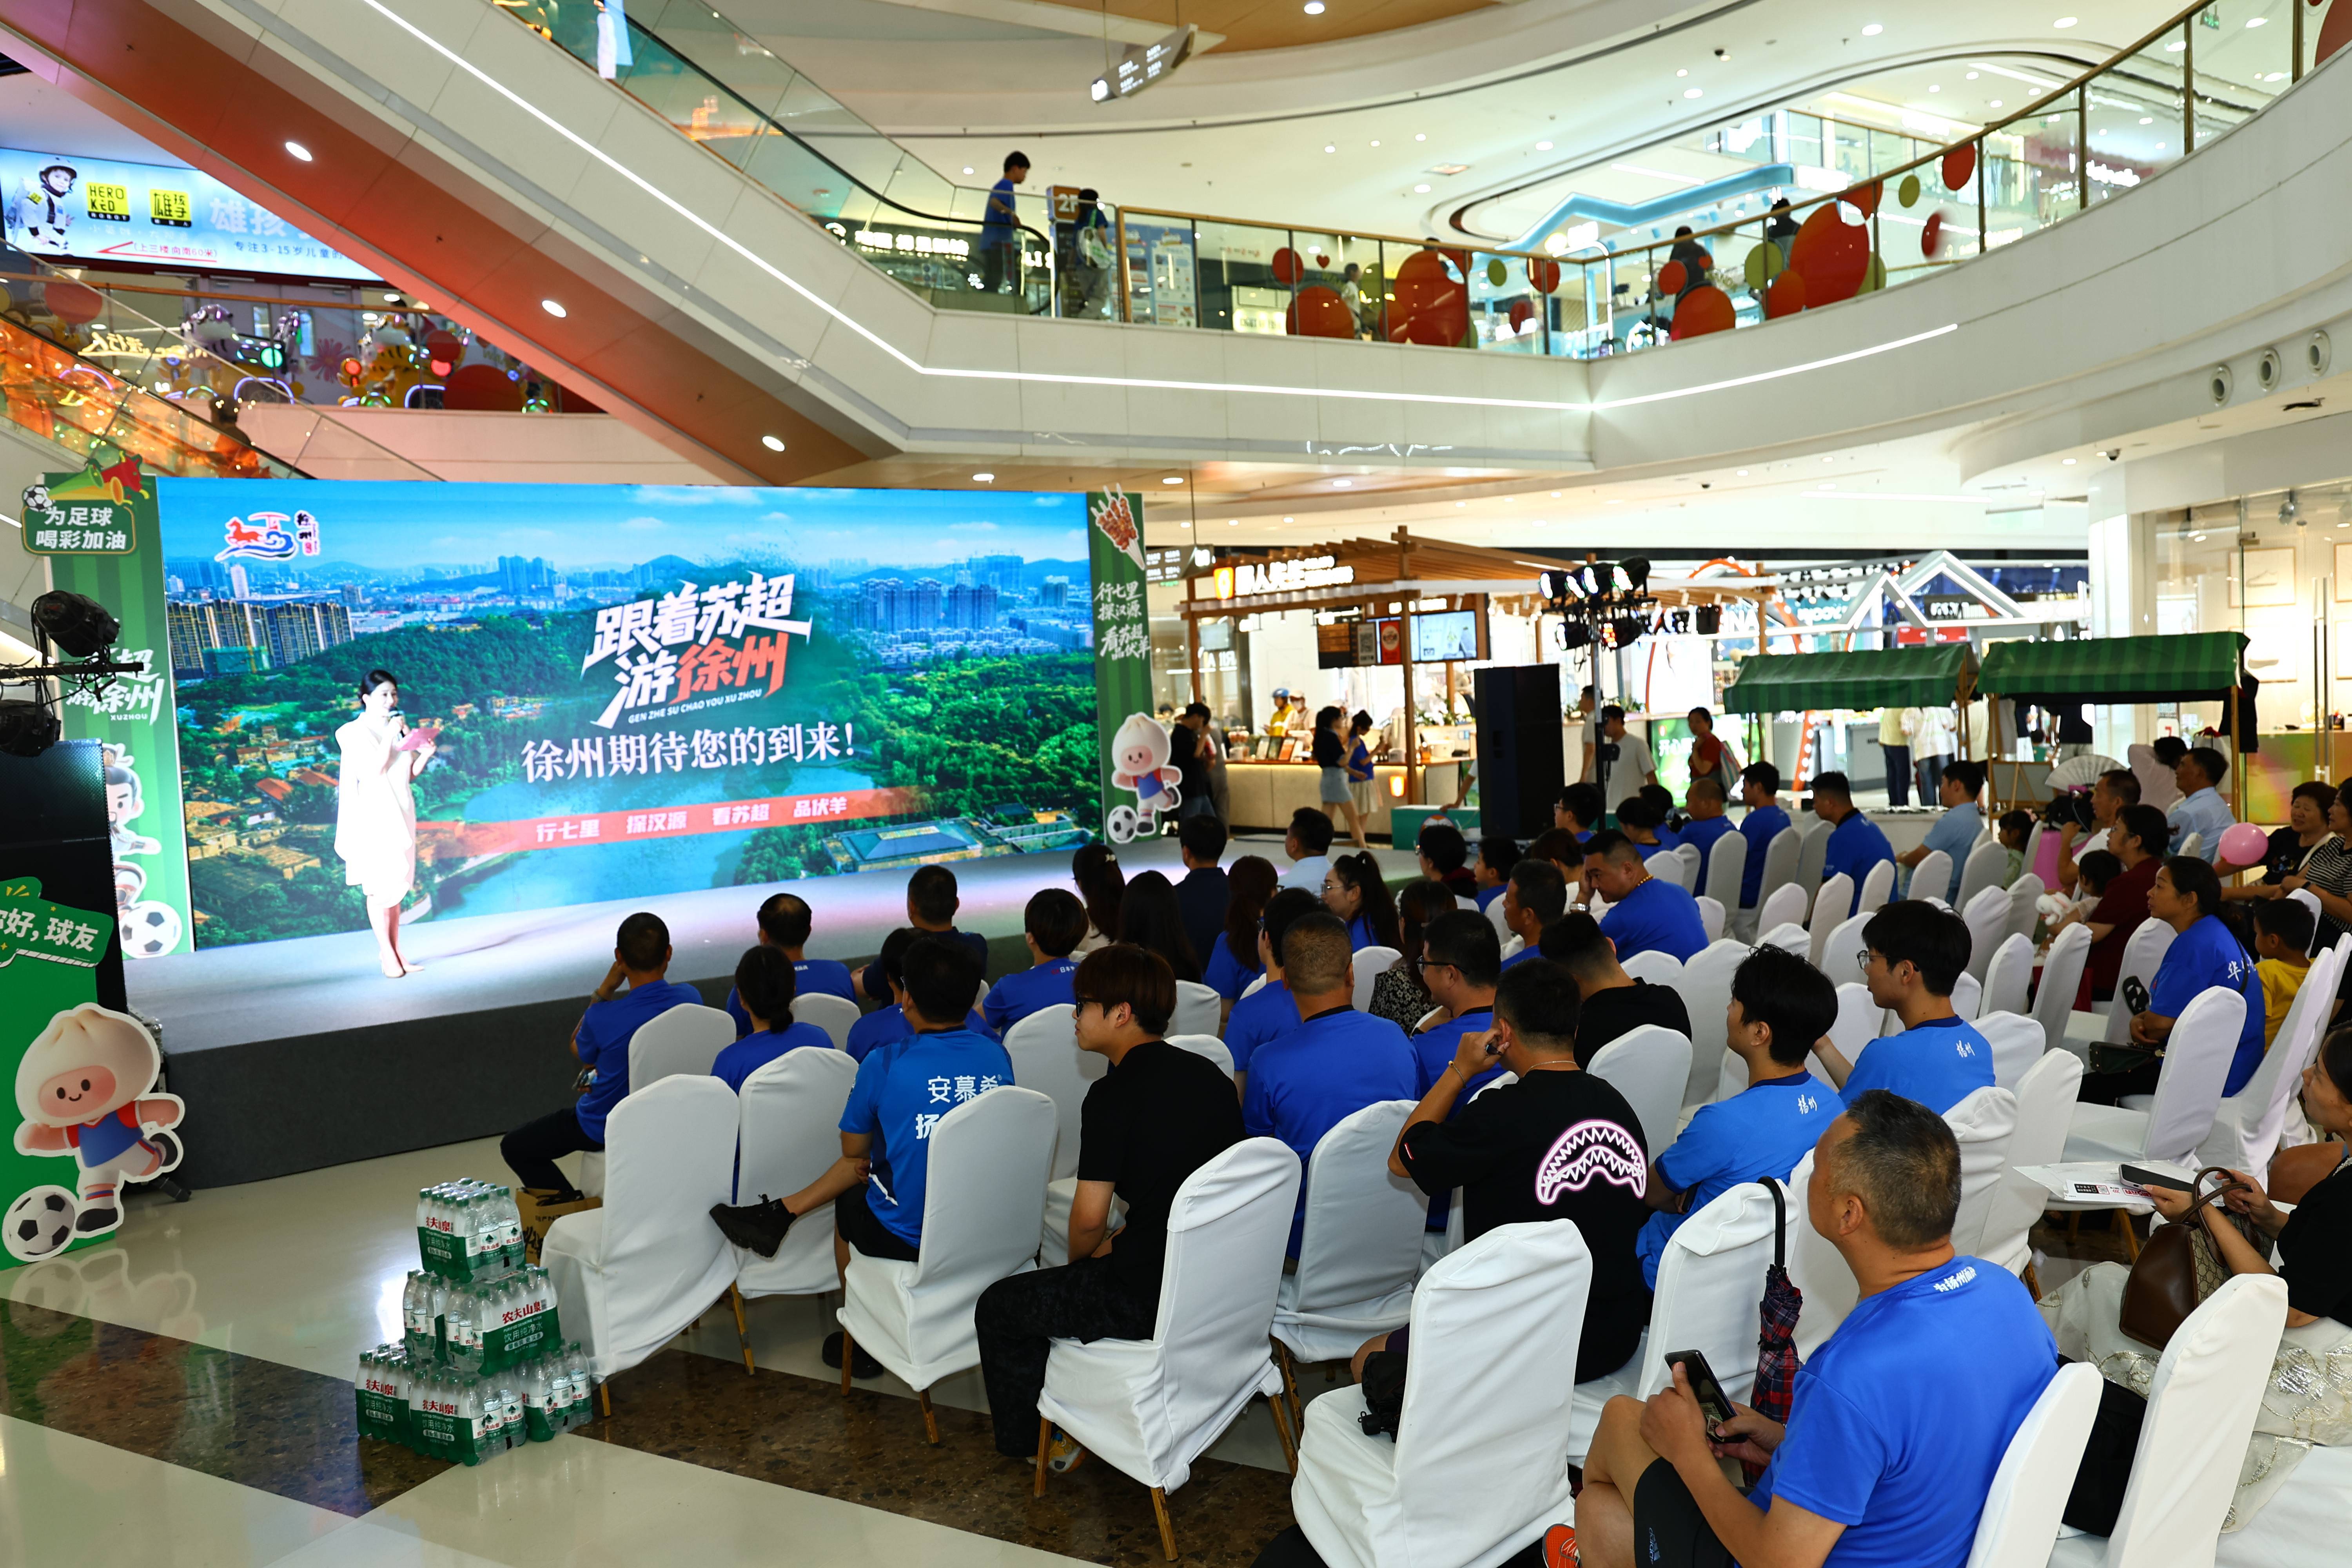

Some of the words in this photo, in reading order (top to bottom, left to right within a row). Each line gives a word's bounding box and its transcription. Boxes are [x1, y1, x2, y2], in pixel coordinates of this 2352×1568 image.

[89, 185, 124, 200] HERO
[234, 241, 353, 260] 专注3-15岁儿童的
[44, 506, 113, 527] 为足球
[35, 530, 127, 550] 喝彩加油
[1093, 580, 1143, 603] 行七里
[1098, 600, 1142, 621] 探汉源
[580, 570, 813, 681] 跟着苏超
[1100, 622, 1143, 657] 看苏超
[1112, 635, 1151, 661] 品伏羊
[590, 632, 789, 729] 游徐州
[110, 713, 149, 721] XUZHOU
[628, 712, 647, 724] GEN
[648, 708, 666, 720] ZHE
[667, 705, 680, 716] SU
[681, 700, 705, 713] CHAO
[706, 696, 724, 708] YOU
[724, 692, 737, 704] XU
[737, 688, 762, 701] ZHOU
[536, 818, 600, 842] 行七里
[627, 811, 687, 834] 探汉源
[712, 803, 770, 826] 看苏超
[793, 796, 847, 818] 品伏羊
[0, 907, 98, 952] 好，球友
[927, 1075, 999, 1104] 安慕希
[502, 1300, 541, 1324] 农夫山泉
[504, 1321, 543, 1343] 饮用纯净水
